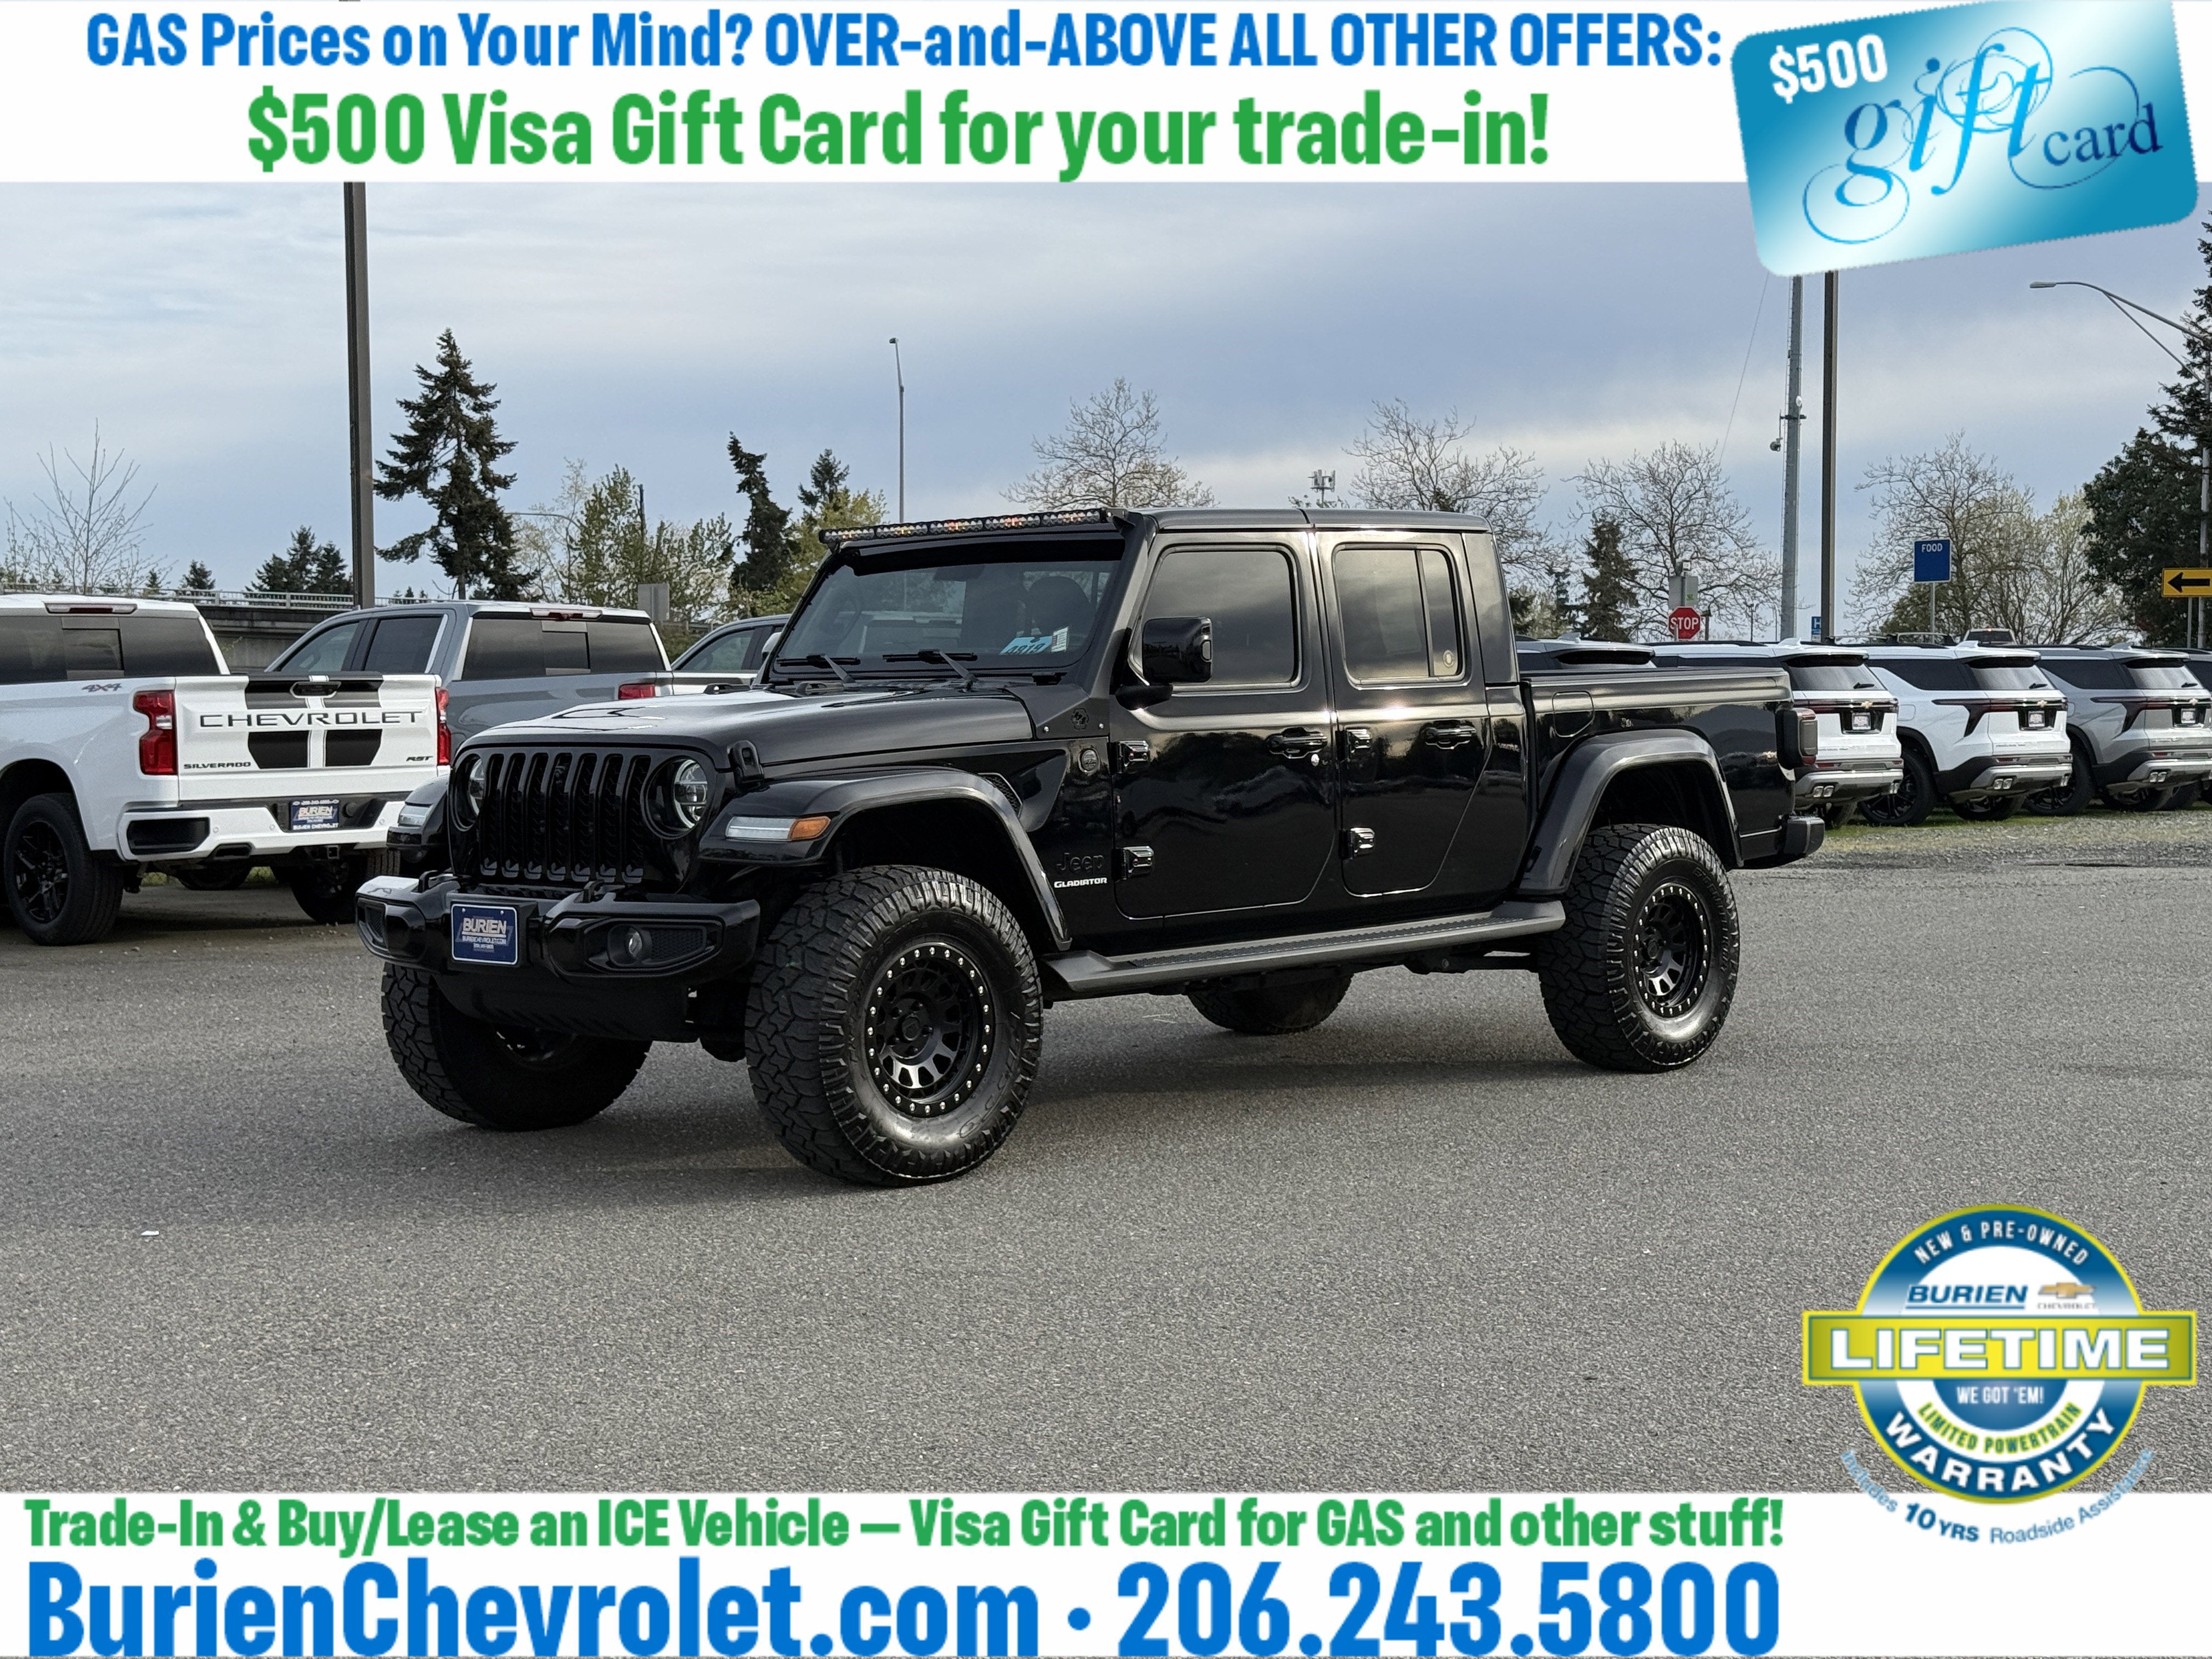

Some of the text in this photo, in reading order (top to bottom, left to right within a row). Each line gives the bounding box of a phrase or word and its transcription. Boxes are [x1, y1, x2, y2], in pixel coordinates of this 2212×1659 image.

[1921, 543, 1943, 552] FOOD
[1670, 617, 1699, 630] STOP
[200, 711, 423, 727] CHEVROLET
[298, 805, 333, 816] BURIEN
[1057, 853, 1104, 874] Jeep
[1054, 878, 1107, 888] GLADIATOR
[462, 917, 507, 934] BURIEN
